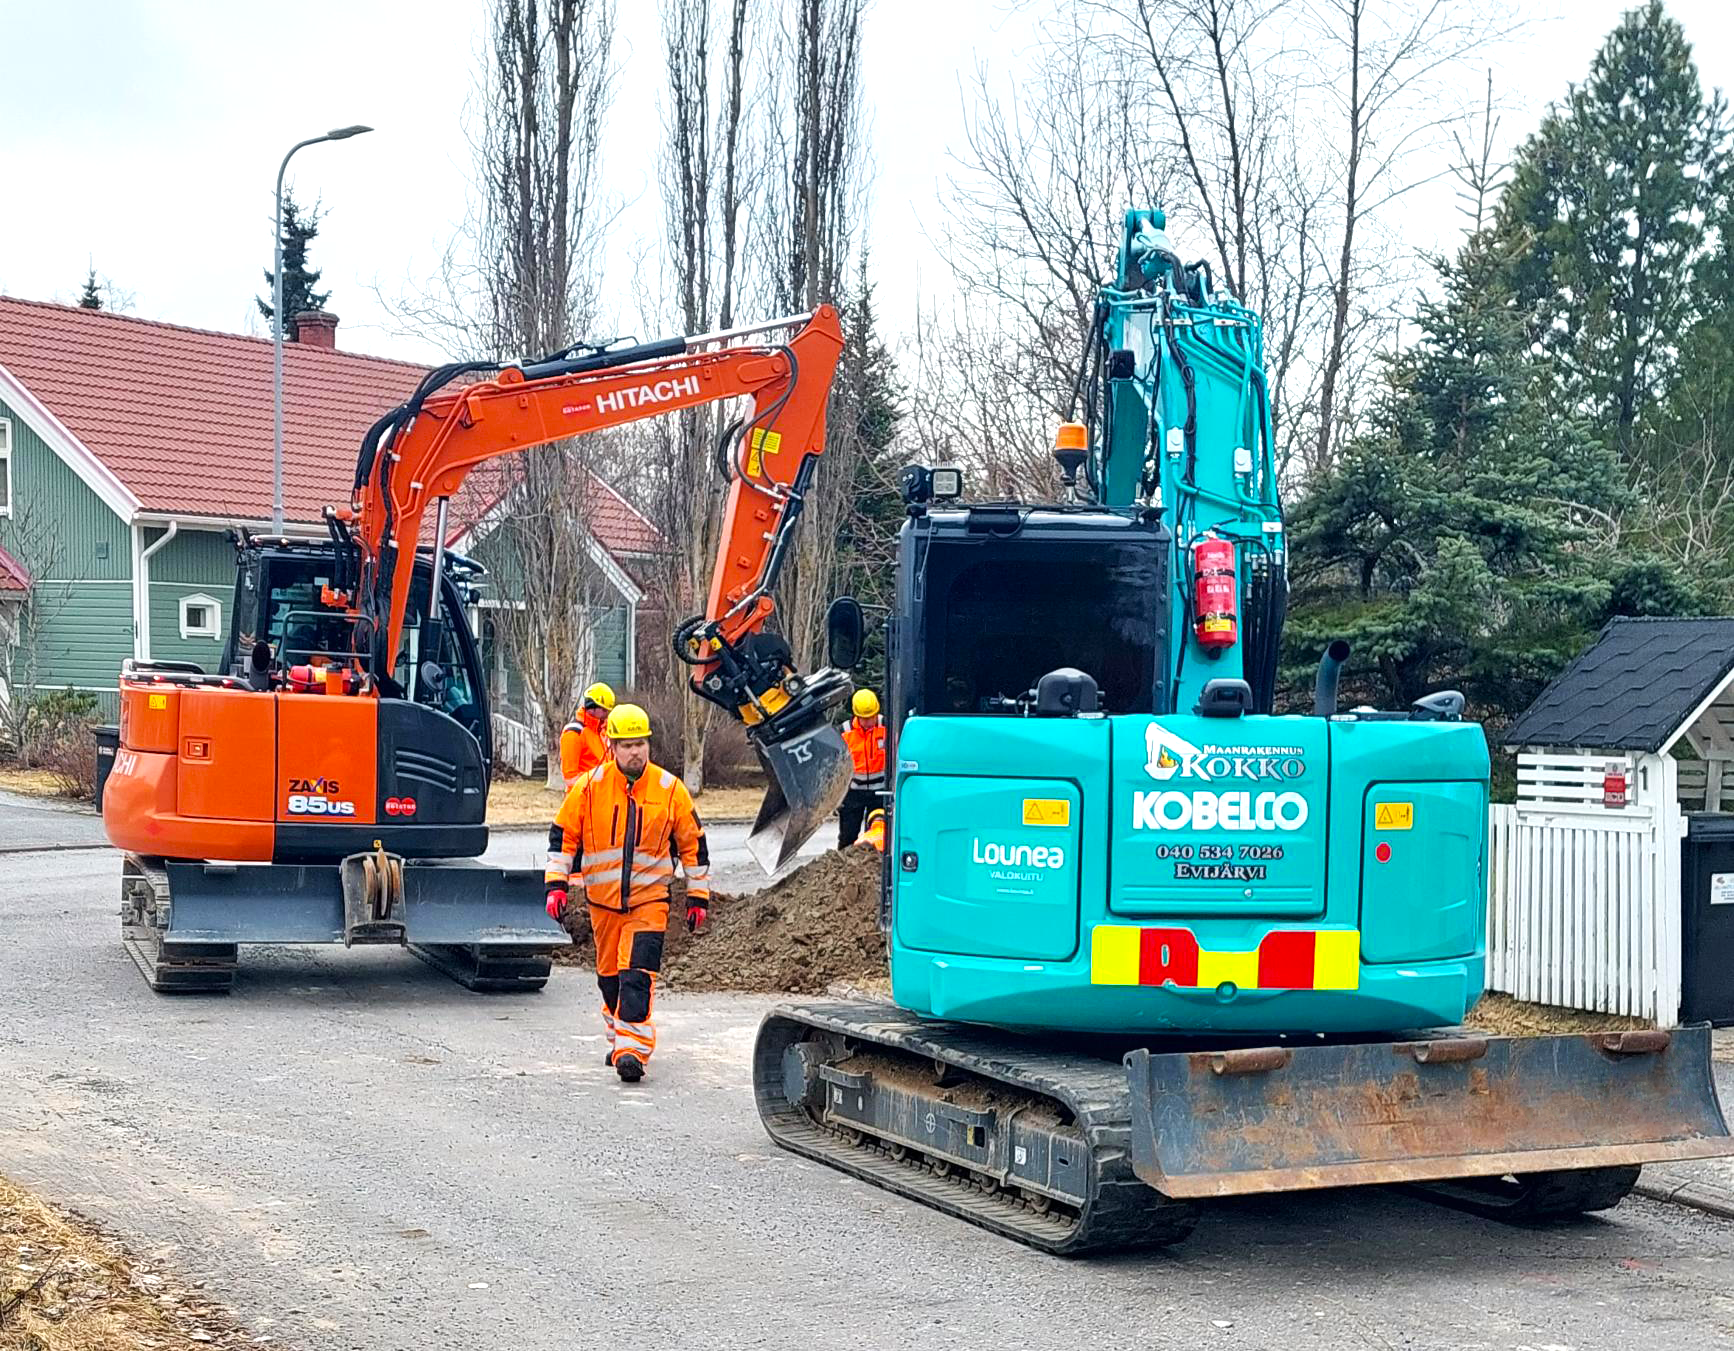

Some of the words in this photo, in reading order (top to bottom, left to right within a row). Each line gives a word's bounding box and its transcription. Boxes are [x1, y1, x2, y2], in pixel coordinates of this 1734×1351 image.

[596, 376, 700, 413] HITACHI
[1202, 744, 1304, 756] MAANRAKENNUS
[1179, 753, 1306, 782] KOKKO
[1639, 765, 1648, 791] 1
[288, 776, 340, 793] ZAXIS
[1132, 791, 1309, 831] KOBELCO
[972, 836, 1064, 869] Lounea
[1156, 844, 1194, 859] 040
[1199, 844, 1233, 859] 534
[1239, 844, 1284, 859] 7026
[988, 870, 1044, 882] VALOKUITU
[1174, 861, 1267, 882] EVIJÄRVI
